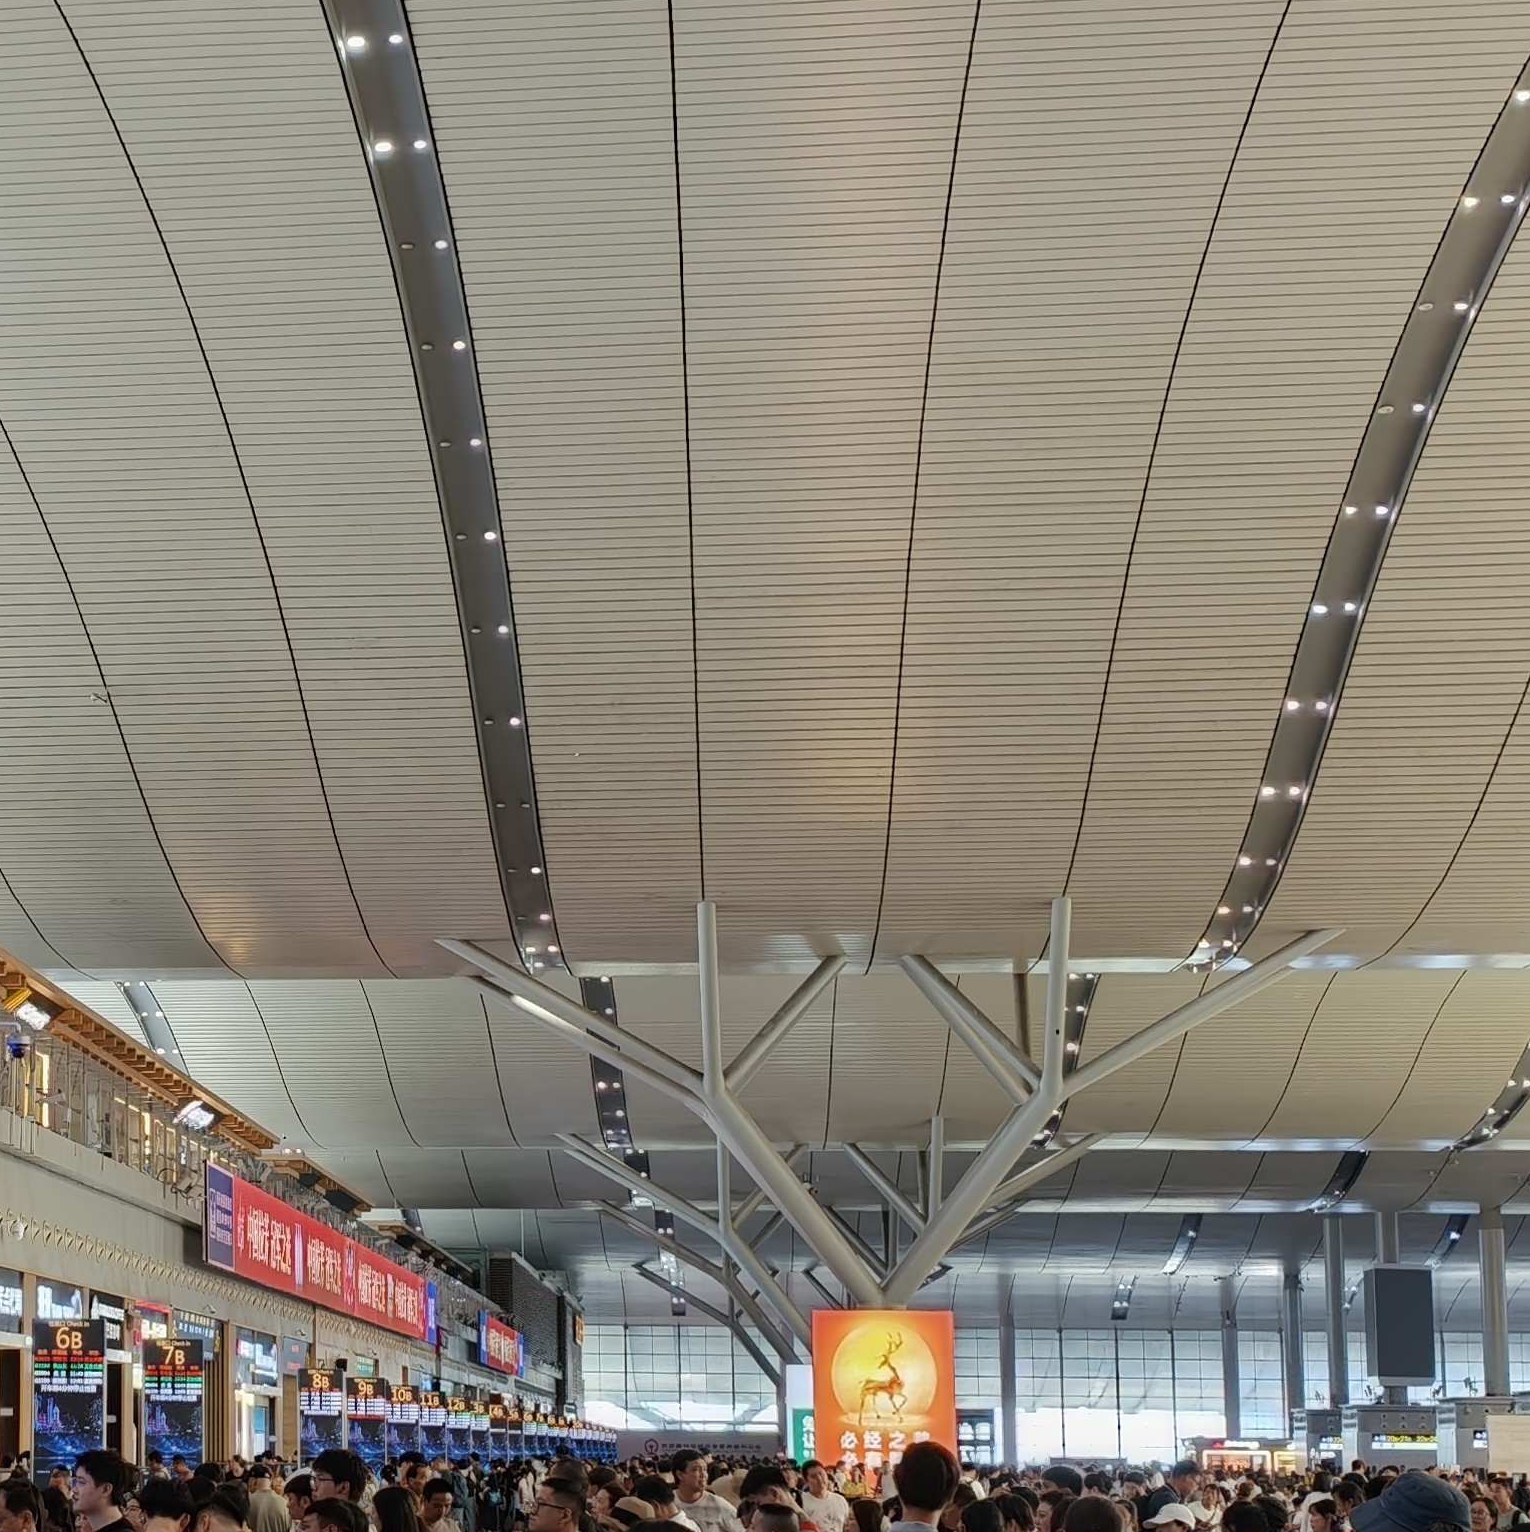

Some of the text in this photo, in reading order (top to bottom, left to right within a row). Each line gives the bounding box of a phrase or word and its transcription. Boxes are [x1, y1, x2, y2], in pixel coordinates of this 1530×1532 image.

[56, 1326, 83, 1349] 6B
[162, 1345, 185, 1365] 7B
[312, 1373, 329, 1388] 8B
[358, 1381, 373, 1395] 9B
[391, 1389, 412, 1402] 10B
